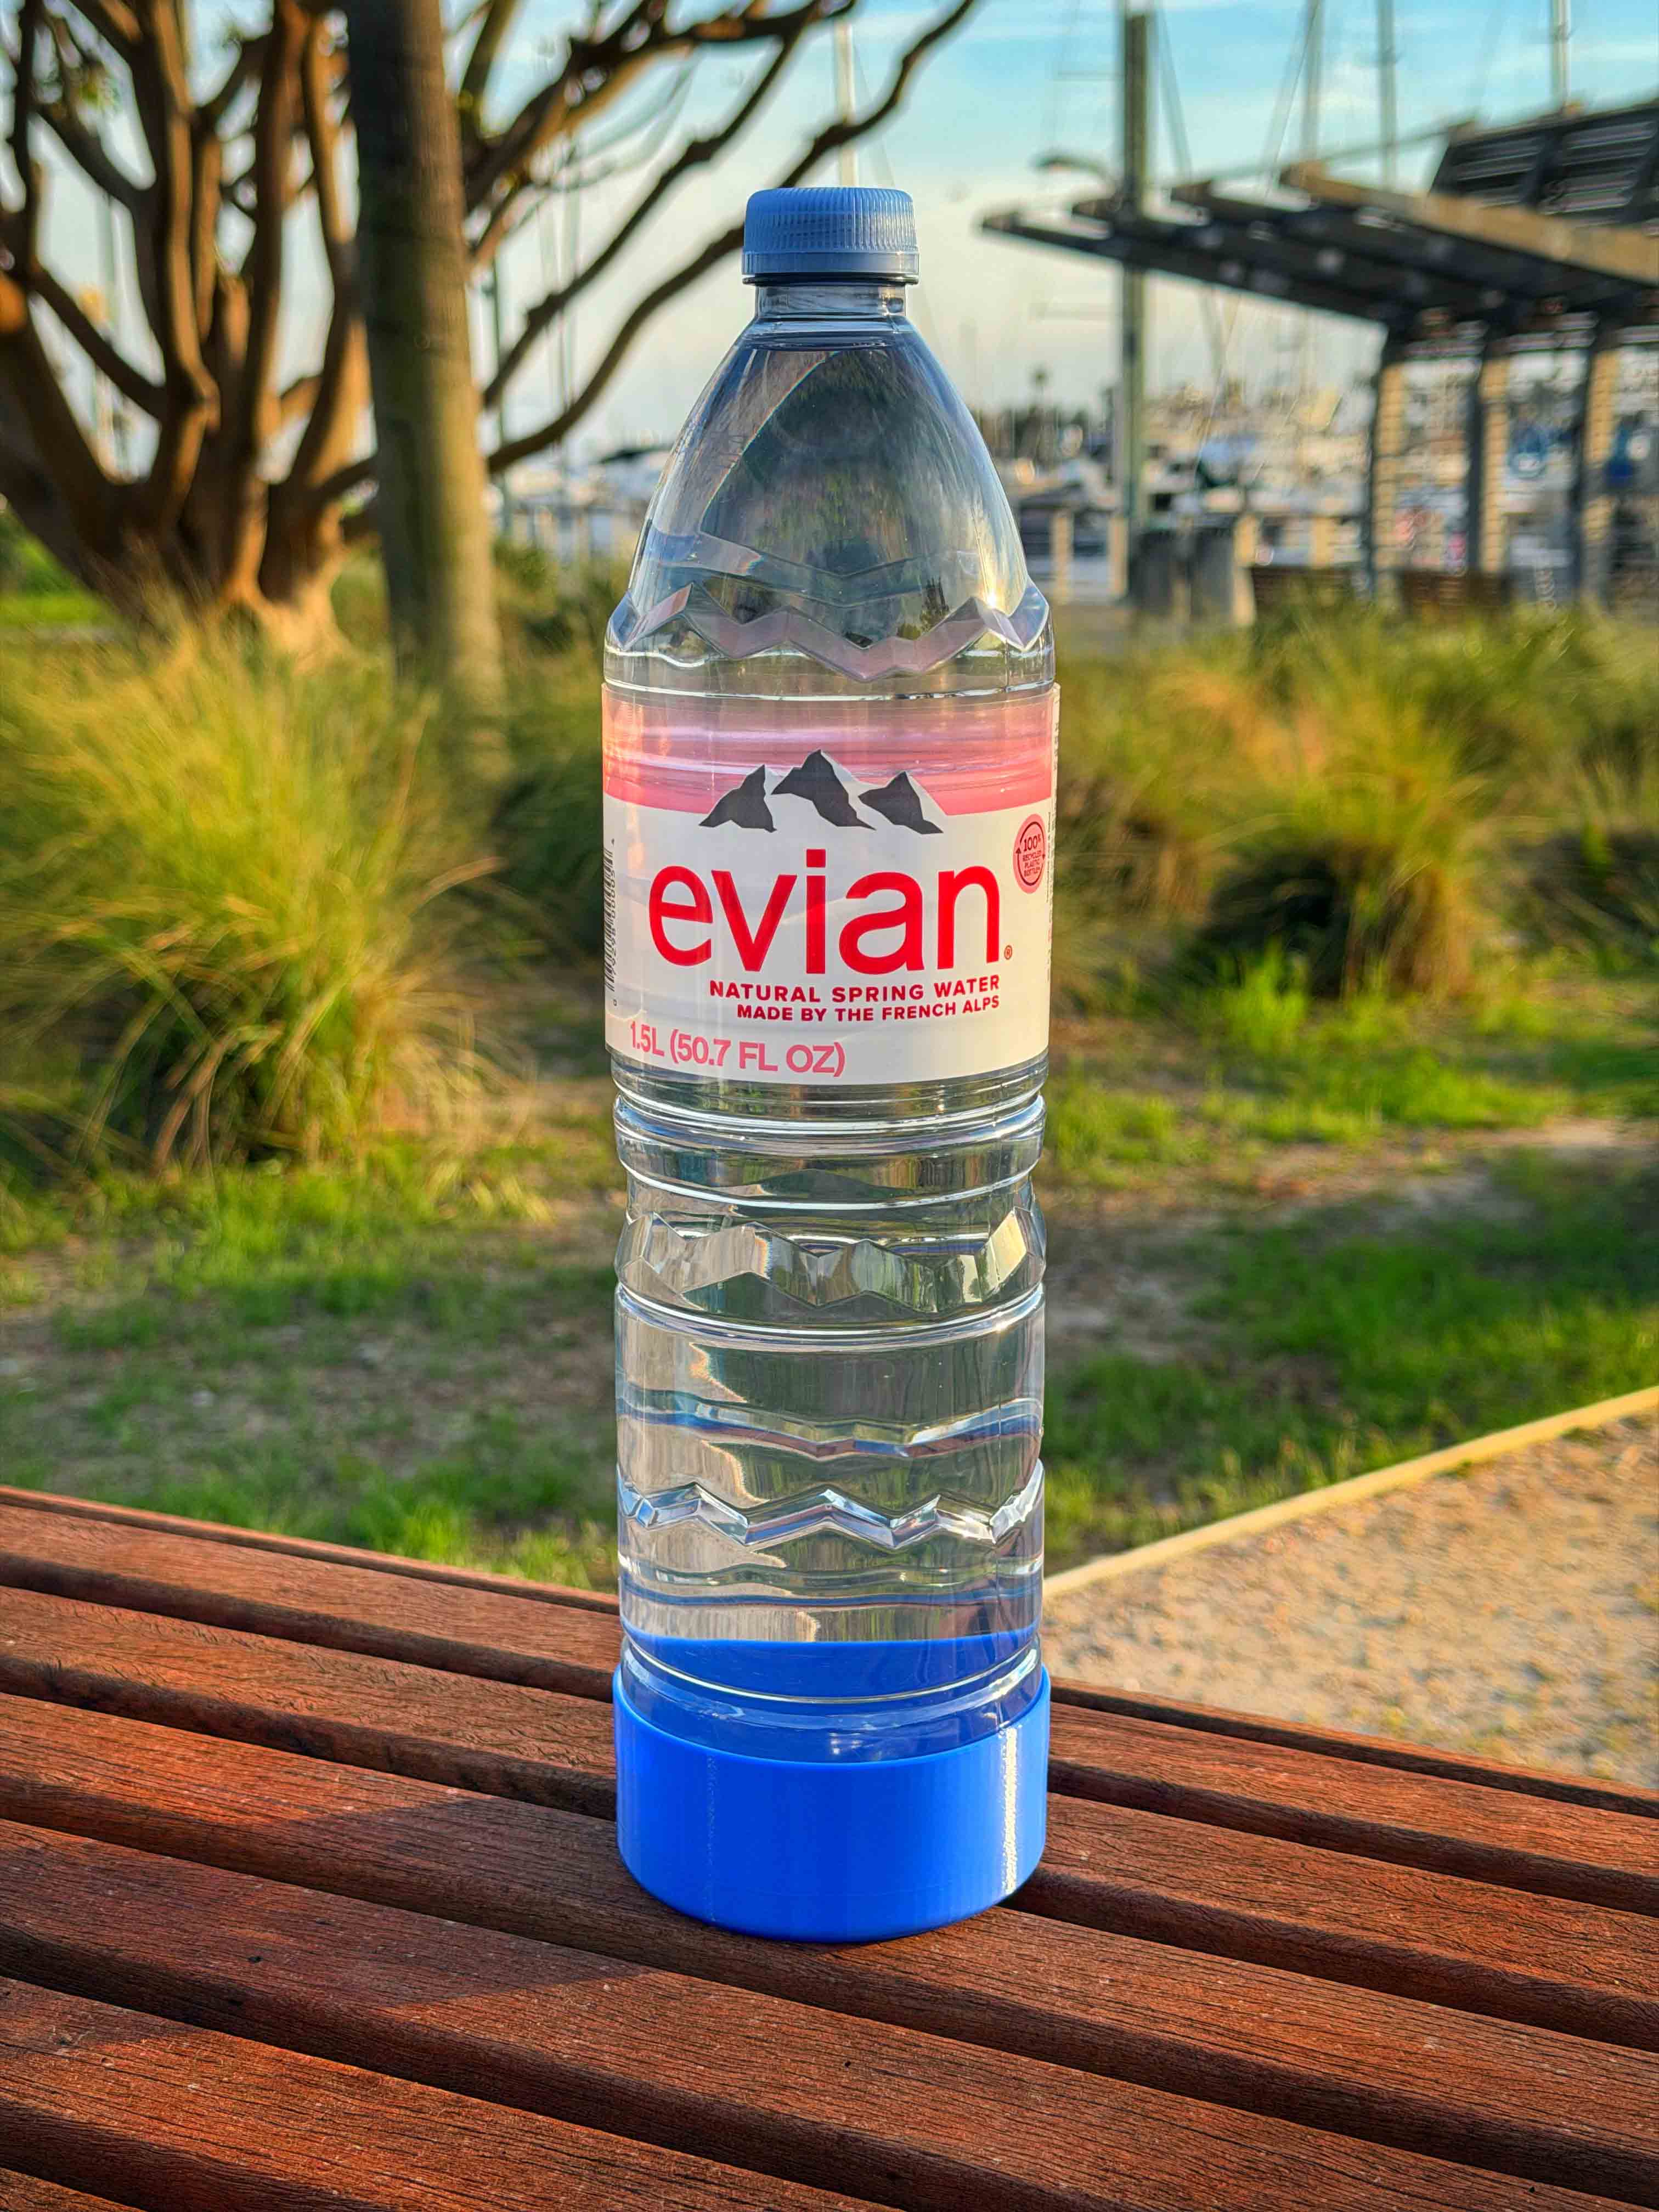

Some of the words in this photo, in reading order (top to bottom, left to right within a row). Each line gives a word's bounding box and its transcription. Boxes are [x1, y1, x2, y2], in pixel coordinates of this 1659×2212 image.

[648, 849, 1000, 974] evian
[709, 980, 821, 1003] NATURAL
[832, 984, 924, 1003] SPRING
[934, 974, 1000, 998] WATER
[737, 1004, 793, 1021] MADE
[801, 1008, 827, 1022] BY
[835, 1008, 874, 1022] THE
[882, 1002, 956, 1020] FRENCH
[962, 995, 1000, 1014] ALPS
[630, 1021, 665, 1057] 1.5L
[669, 1029, 731, 1067] (50.7
[738, 1041, 778, 1071] FL
[786, 1042, 846, 1078] OZ)
